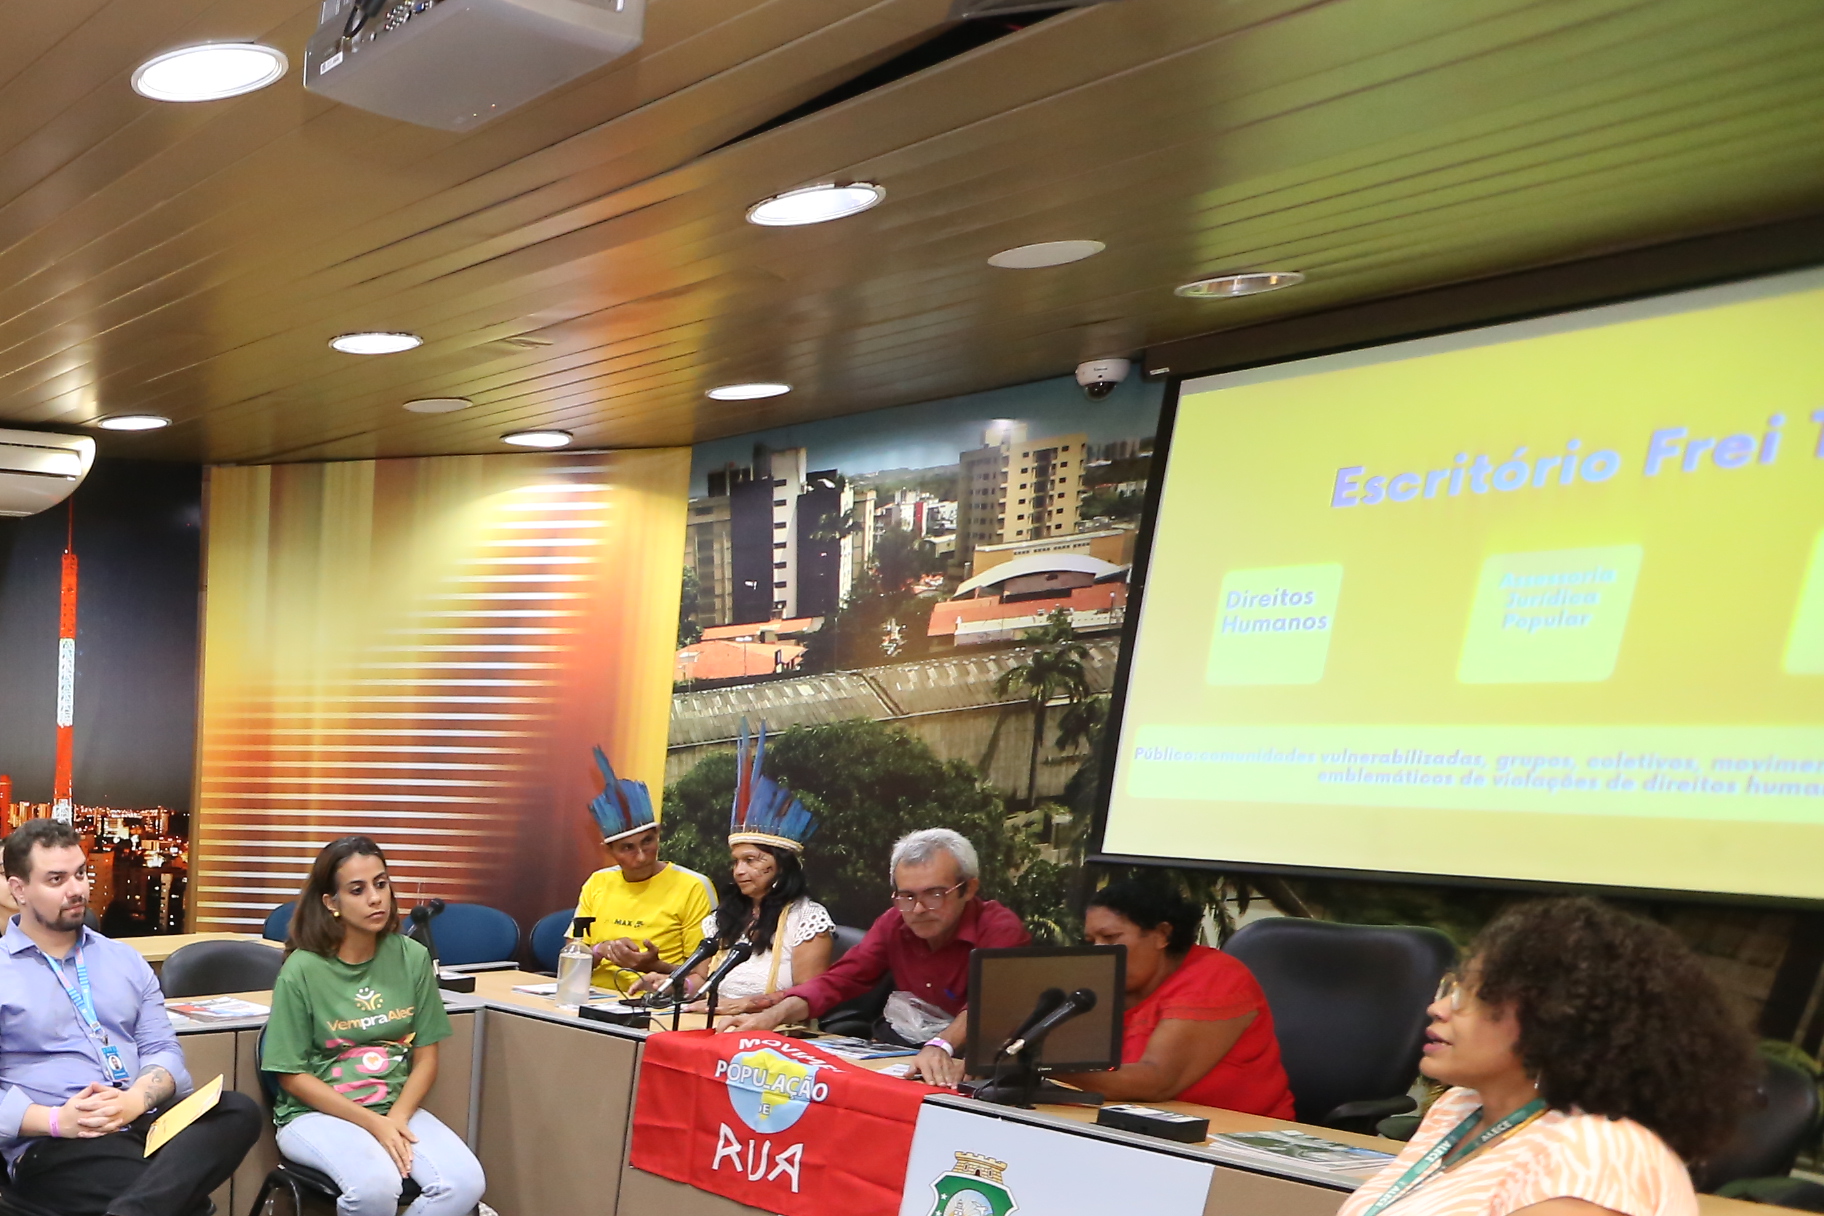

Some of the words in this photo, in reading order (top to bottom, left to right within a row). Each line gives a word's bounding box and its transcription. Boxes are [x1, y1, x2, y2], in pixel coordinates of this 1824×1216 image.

[1332, 438, 1622, 507] Escritório
[1643, 413, 1786, 476] Frei
[1226, 587, 1314, 609] Direitos
[1221, 615, 1328, 633] Humanos
[1502, 610, 1592, 634] Popular
[1460, 769, 1487, 787] de
[1605, 772, 1637, 792] de
[1642, 772, 1738, 794] direitos
[1480, 1120, 1512, 1142] ALECE
[712, 1122, 804, 1193] RUA
[1425, 1139, 1452, 1163] ALECE
